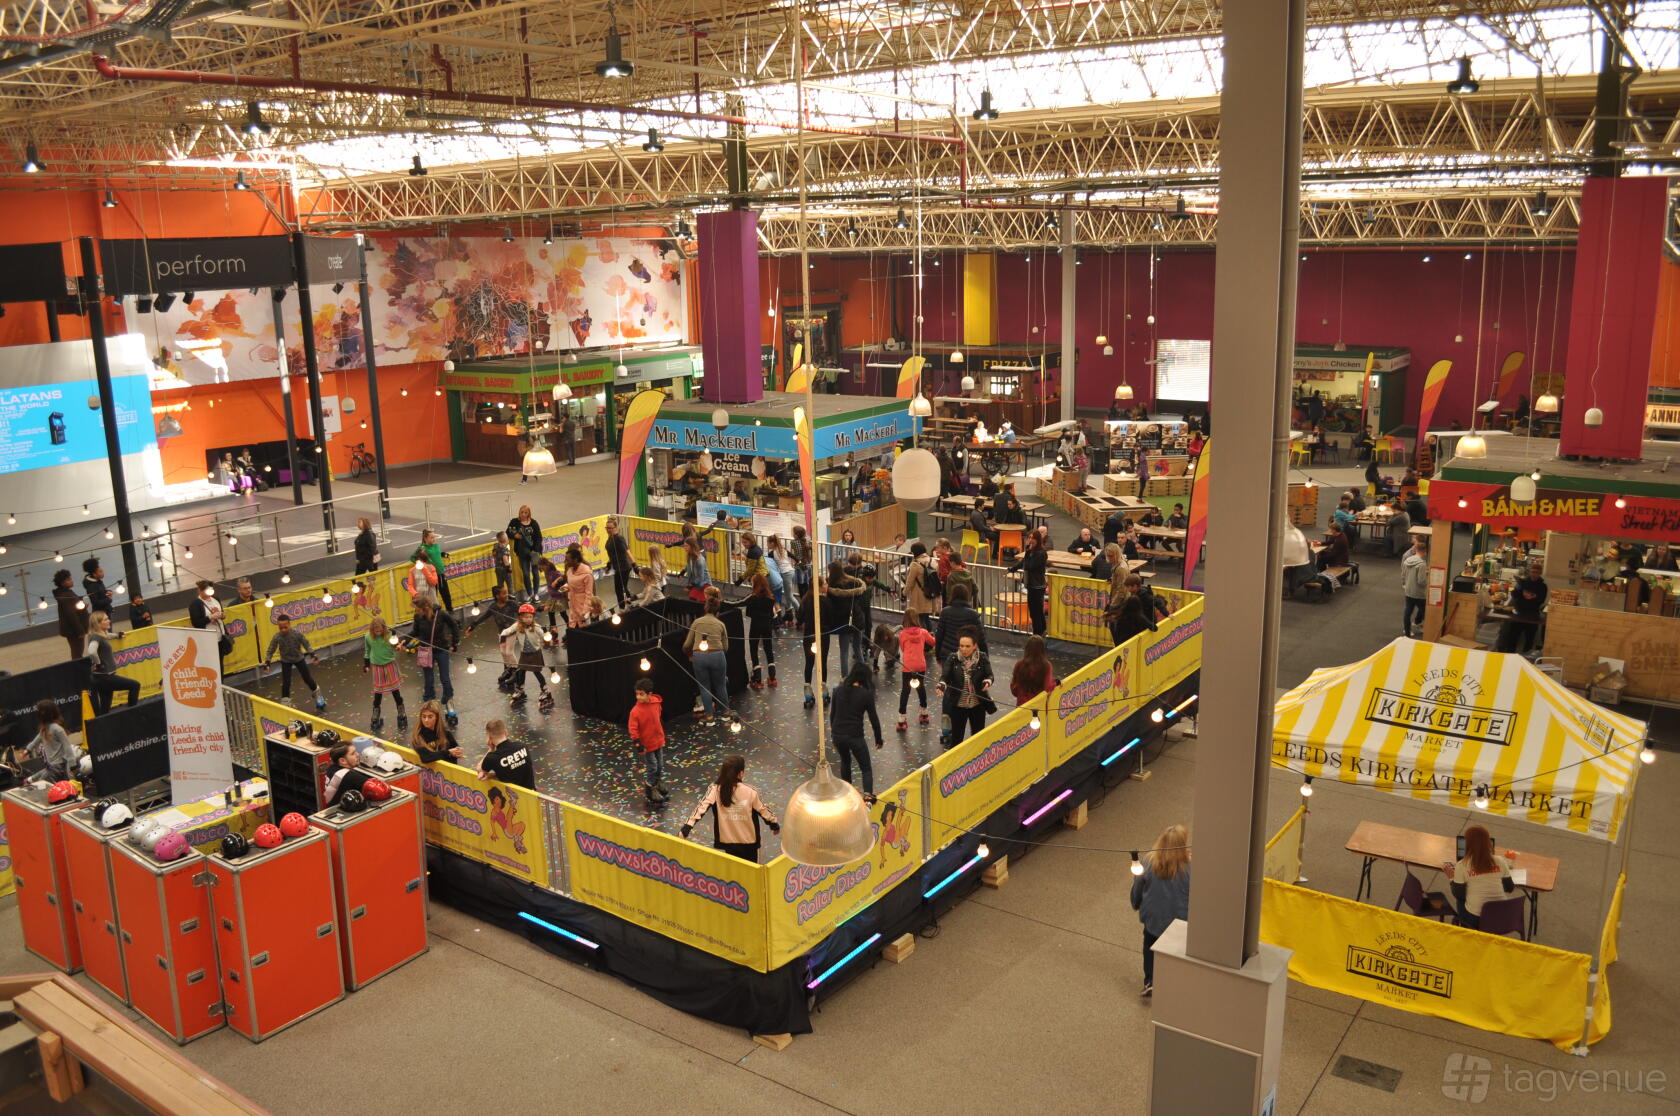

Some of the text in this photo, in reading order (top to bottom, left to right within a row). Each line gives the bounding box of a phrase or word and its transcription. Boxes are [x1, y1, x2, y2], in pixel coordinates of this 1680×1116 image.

[155, 253, 247, 280] perform
[327, 254, 344, 270] create
[1330, 360, 1361, 369] Chicken
[573, 368, 605, 383] BAKERY
[713, 458, 750, 473] Cream
[723, 453, 740, 462] Ice
[316, 614, 347, 630] Disco
[173, 668, 198, 679] child
[175, 677, 214, 690] friendly
[1413, 668, 1486, 697] LEEDS CITY
[177, 688, 206, 700] Leeds
[1378, 697, 1504, 737] KIRKGATE
[169, 725, 201, 735] Making
[206, 731, 225, 741] child
[173, 742, 223, 755] friendly city
[1404, 731, 1463, 750] MARKET
[500, 747, 528, 767] CREW
[1272, 739, 1593, 820] LEEDS KIRKGATE MARKET
[446, 808, 483, 835] Disco
[576, 832, 749, 913] www.sk8hire.co.uk
[797, 885, 835, 926] Roller
[835, 861, 872, 898] Disco
[1376, 931, 1428, 957] LEEDS CITY
[1355, 953, 1445, 990] KIRKGATE
[1375, 983, 1418, 1001] MARKET
